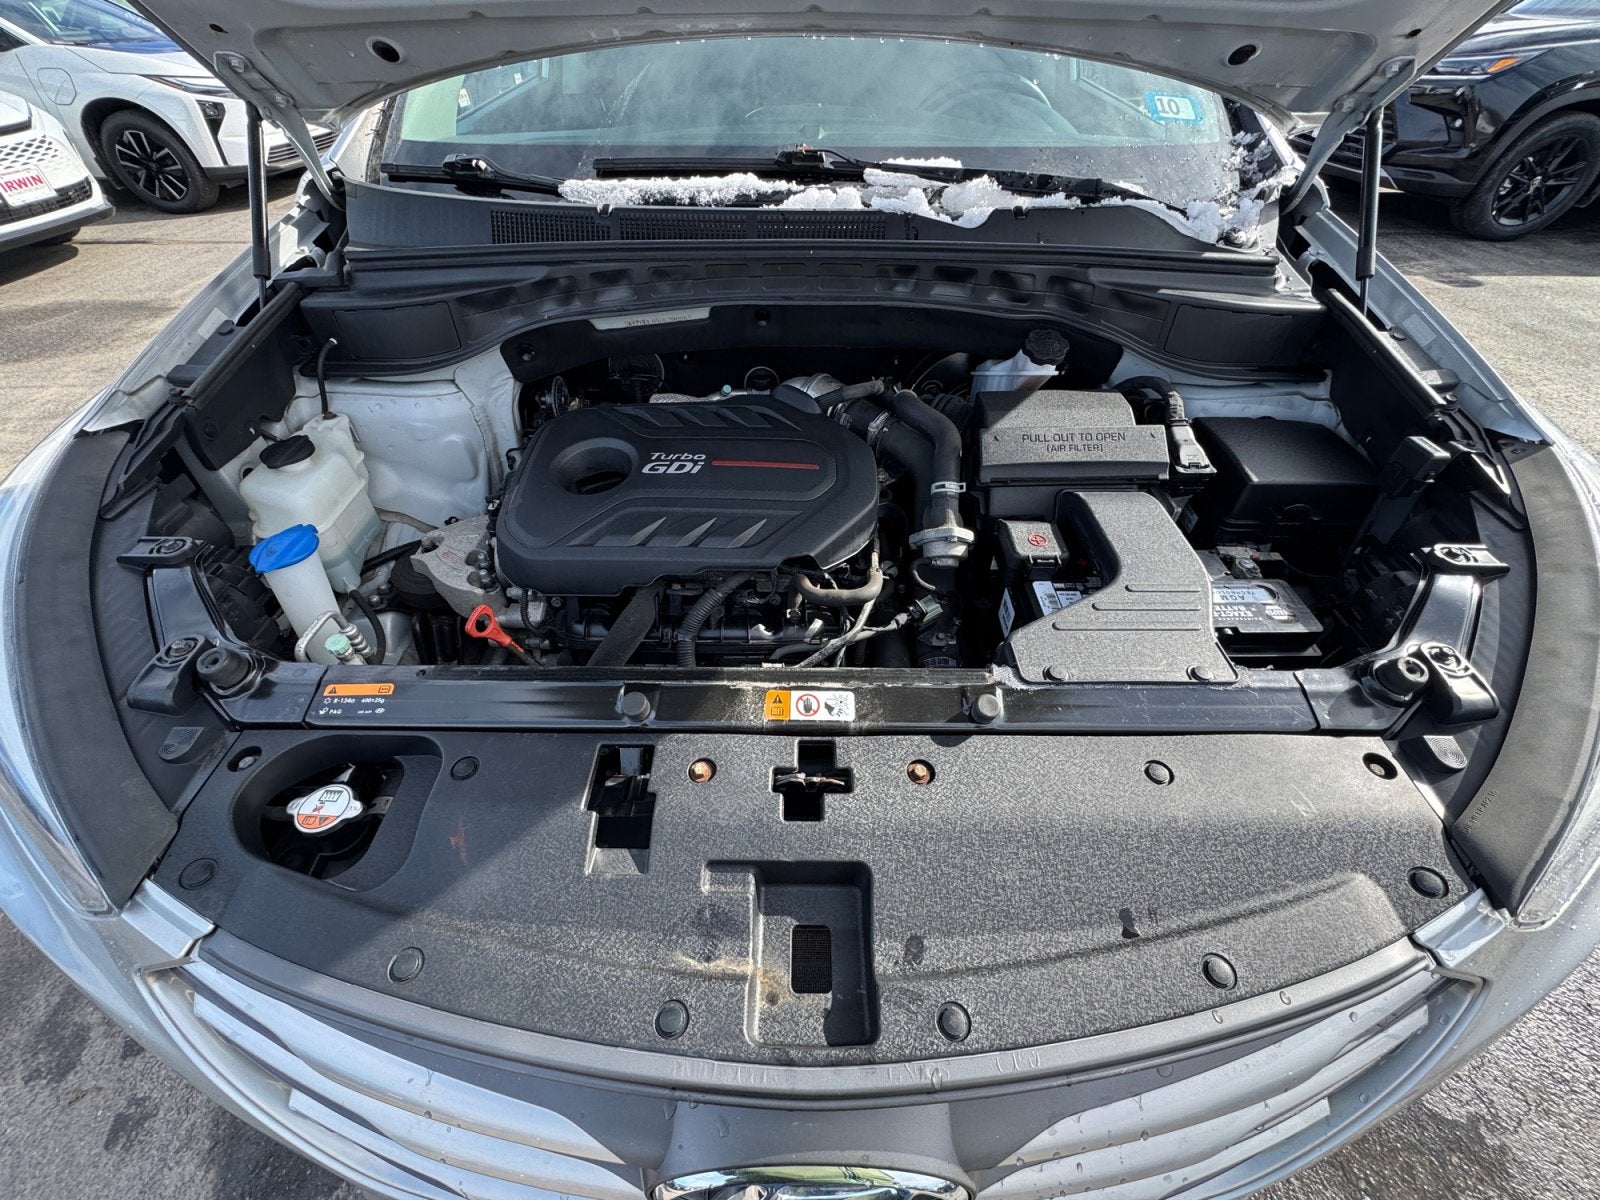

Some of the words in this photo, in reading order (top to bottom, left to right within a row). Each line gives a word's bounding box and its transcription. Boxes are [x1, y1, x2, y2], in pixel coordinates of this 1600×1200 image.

[1156, 97, 1181, 116] 10
[0, 174, 44, 193] IRWIN
[1021, 433, 1050, 443] PULL
[1053, 433, 1075, 442] OUT
[1078, 432, 1093, 442] TO
[1095, 432, 1126, 442] OPEN
[650, 452, 707, 460] Turbo
[641, 461, 705, 474] GDi
